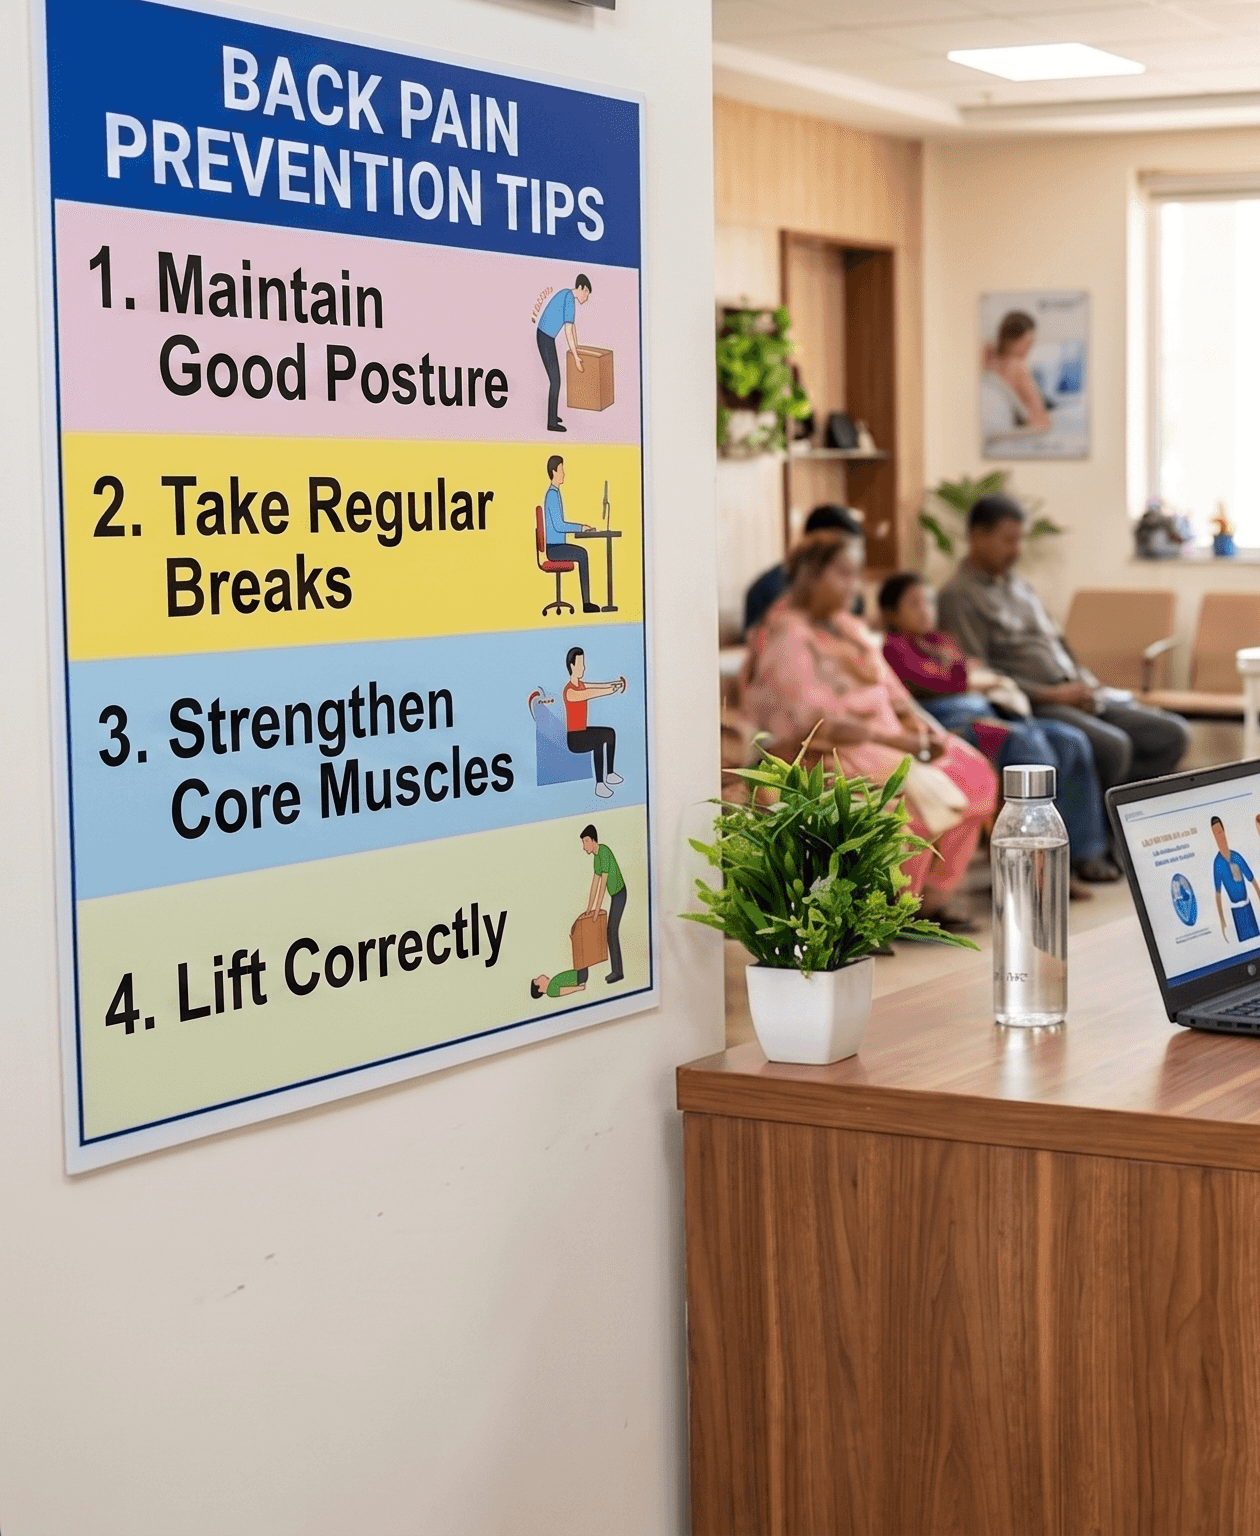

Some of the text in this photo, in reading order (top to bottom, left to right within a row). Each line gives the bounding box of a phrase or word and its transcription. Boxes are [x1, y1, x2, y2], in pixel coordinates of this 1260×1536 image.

[222, 45, 519, 157] BACK PAIN
[105, 112, 605, 242] PREVENTION TIPS
[90, 246, 382, 328] 1. Maintain
[160, 335, 508, 408] Good Posture
[94, 476, 494, 547] 2. Take Regular
[167, 554, 351, 617] Breaks
[99, 681, 453, 767] 3. Strengthen
[172, 746, 513, 839] Core Muscles
[106, 903, 507, 1034] 4. Lift Correctly
